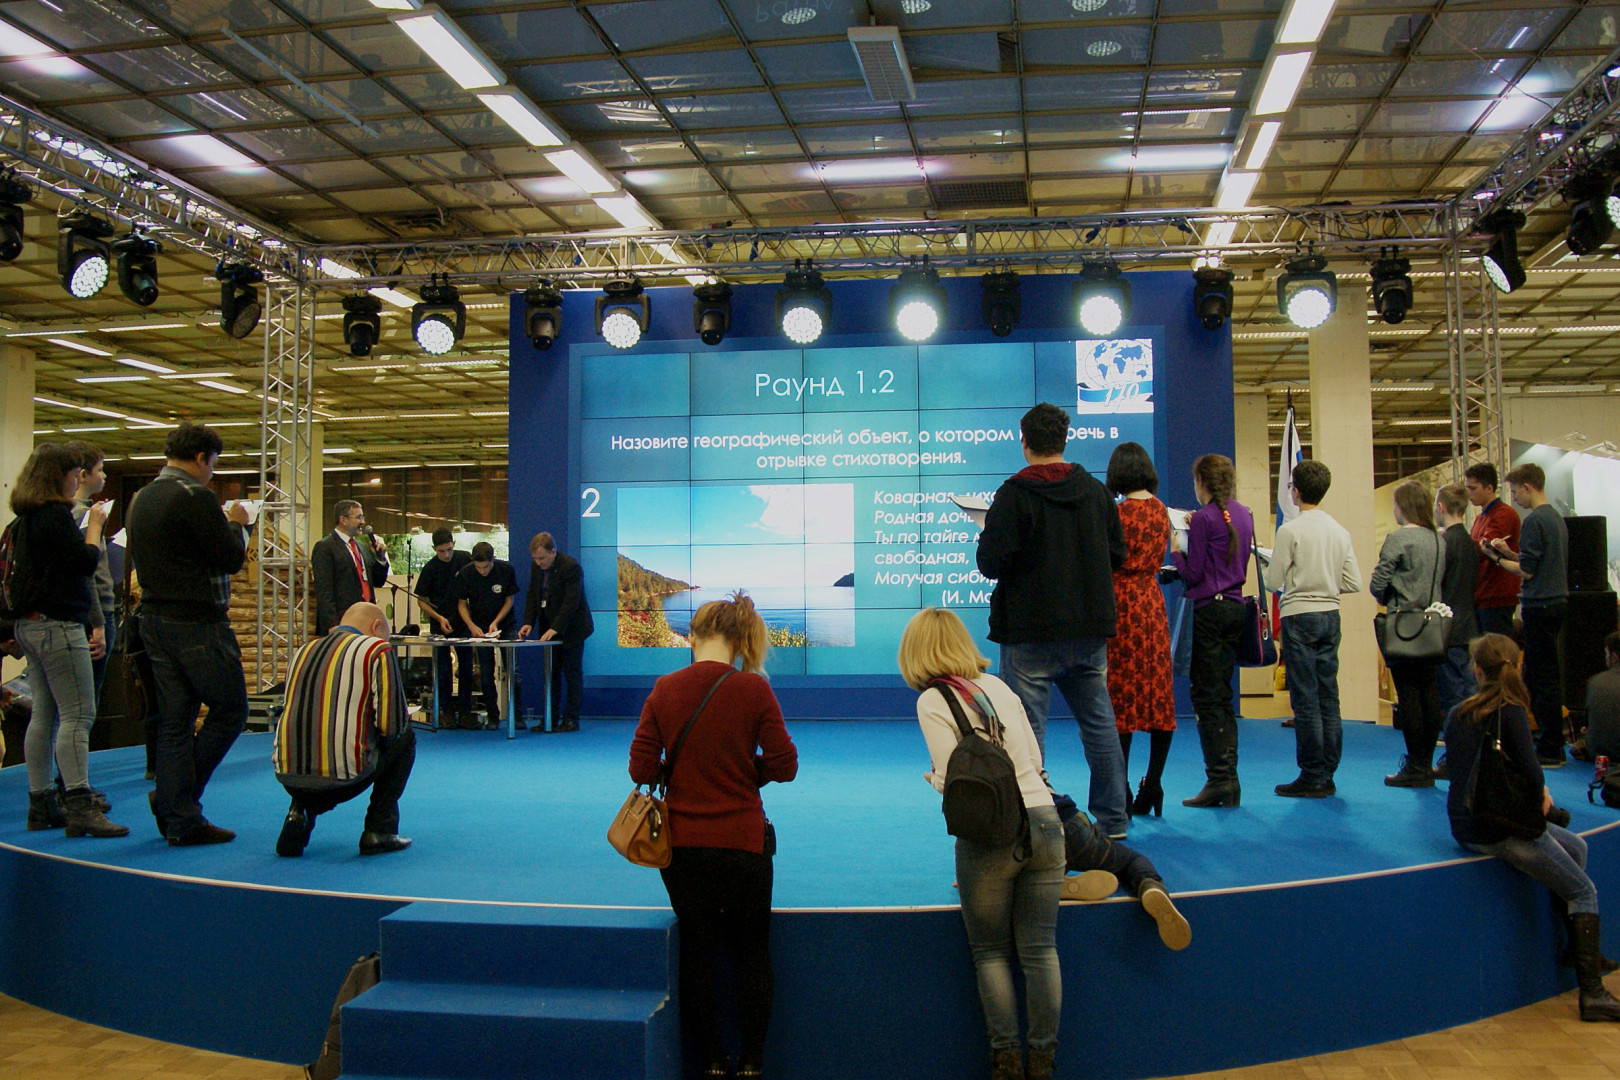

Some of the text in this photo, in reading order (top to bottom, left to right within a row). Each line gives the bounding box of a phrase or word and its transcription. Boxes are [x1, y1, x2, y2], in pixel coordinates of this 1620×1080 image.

[755, 369, 895, 402] Раунд 1.2
[611, 435, 689, 450] Назовите
[693, 428, 844, 451] географический
[847, 428, 913, 445] объект,
[918, 430, 931, 443] о
[934, 428, 1015, 445] котором
[1109, 426, 1119, 439] в
[756, 451, 967, 471] отрывке стихотворения.
[581, 487, 601, 518] 2
[873, 490, 954, 507] Коварная
[874, 509, 935, 526] Родная
[874, 530, 894, 545] Ты
[897, 532, 919, 545] по
[923, 528, 970, 545] тайге
[874, 549, 970, 566] свободная,
[874, 570, 944, 588] Могучая
[941, 589, 964, 608] (И.
